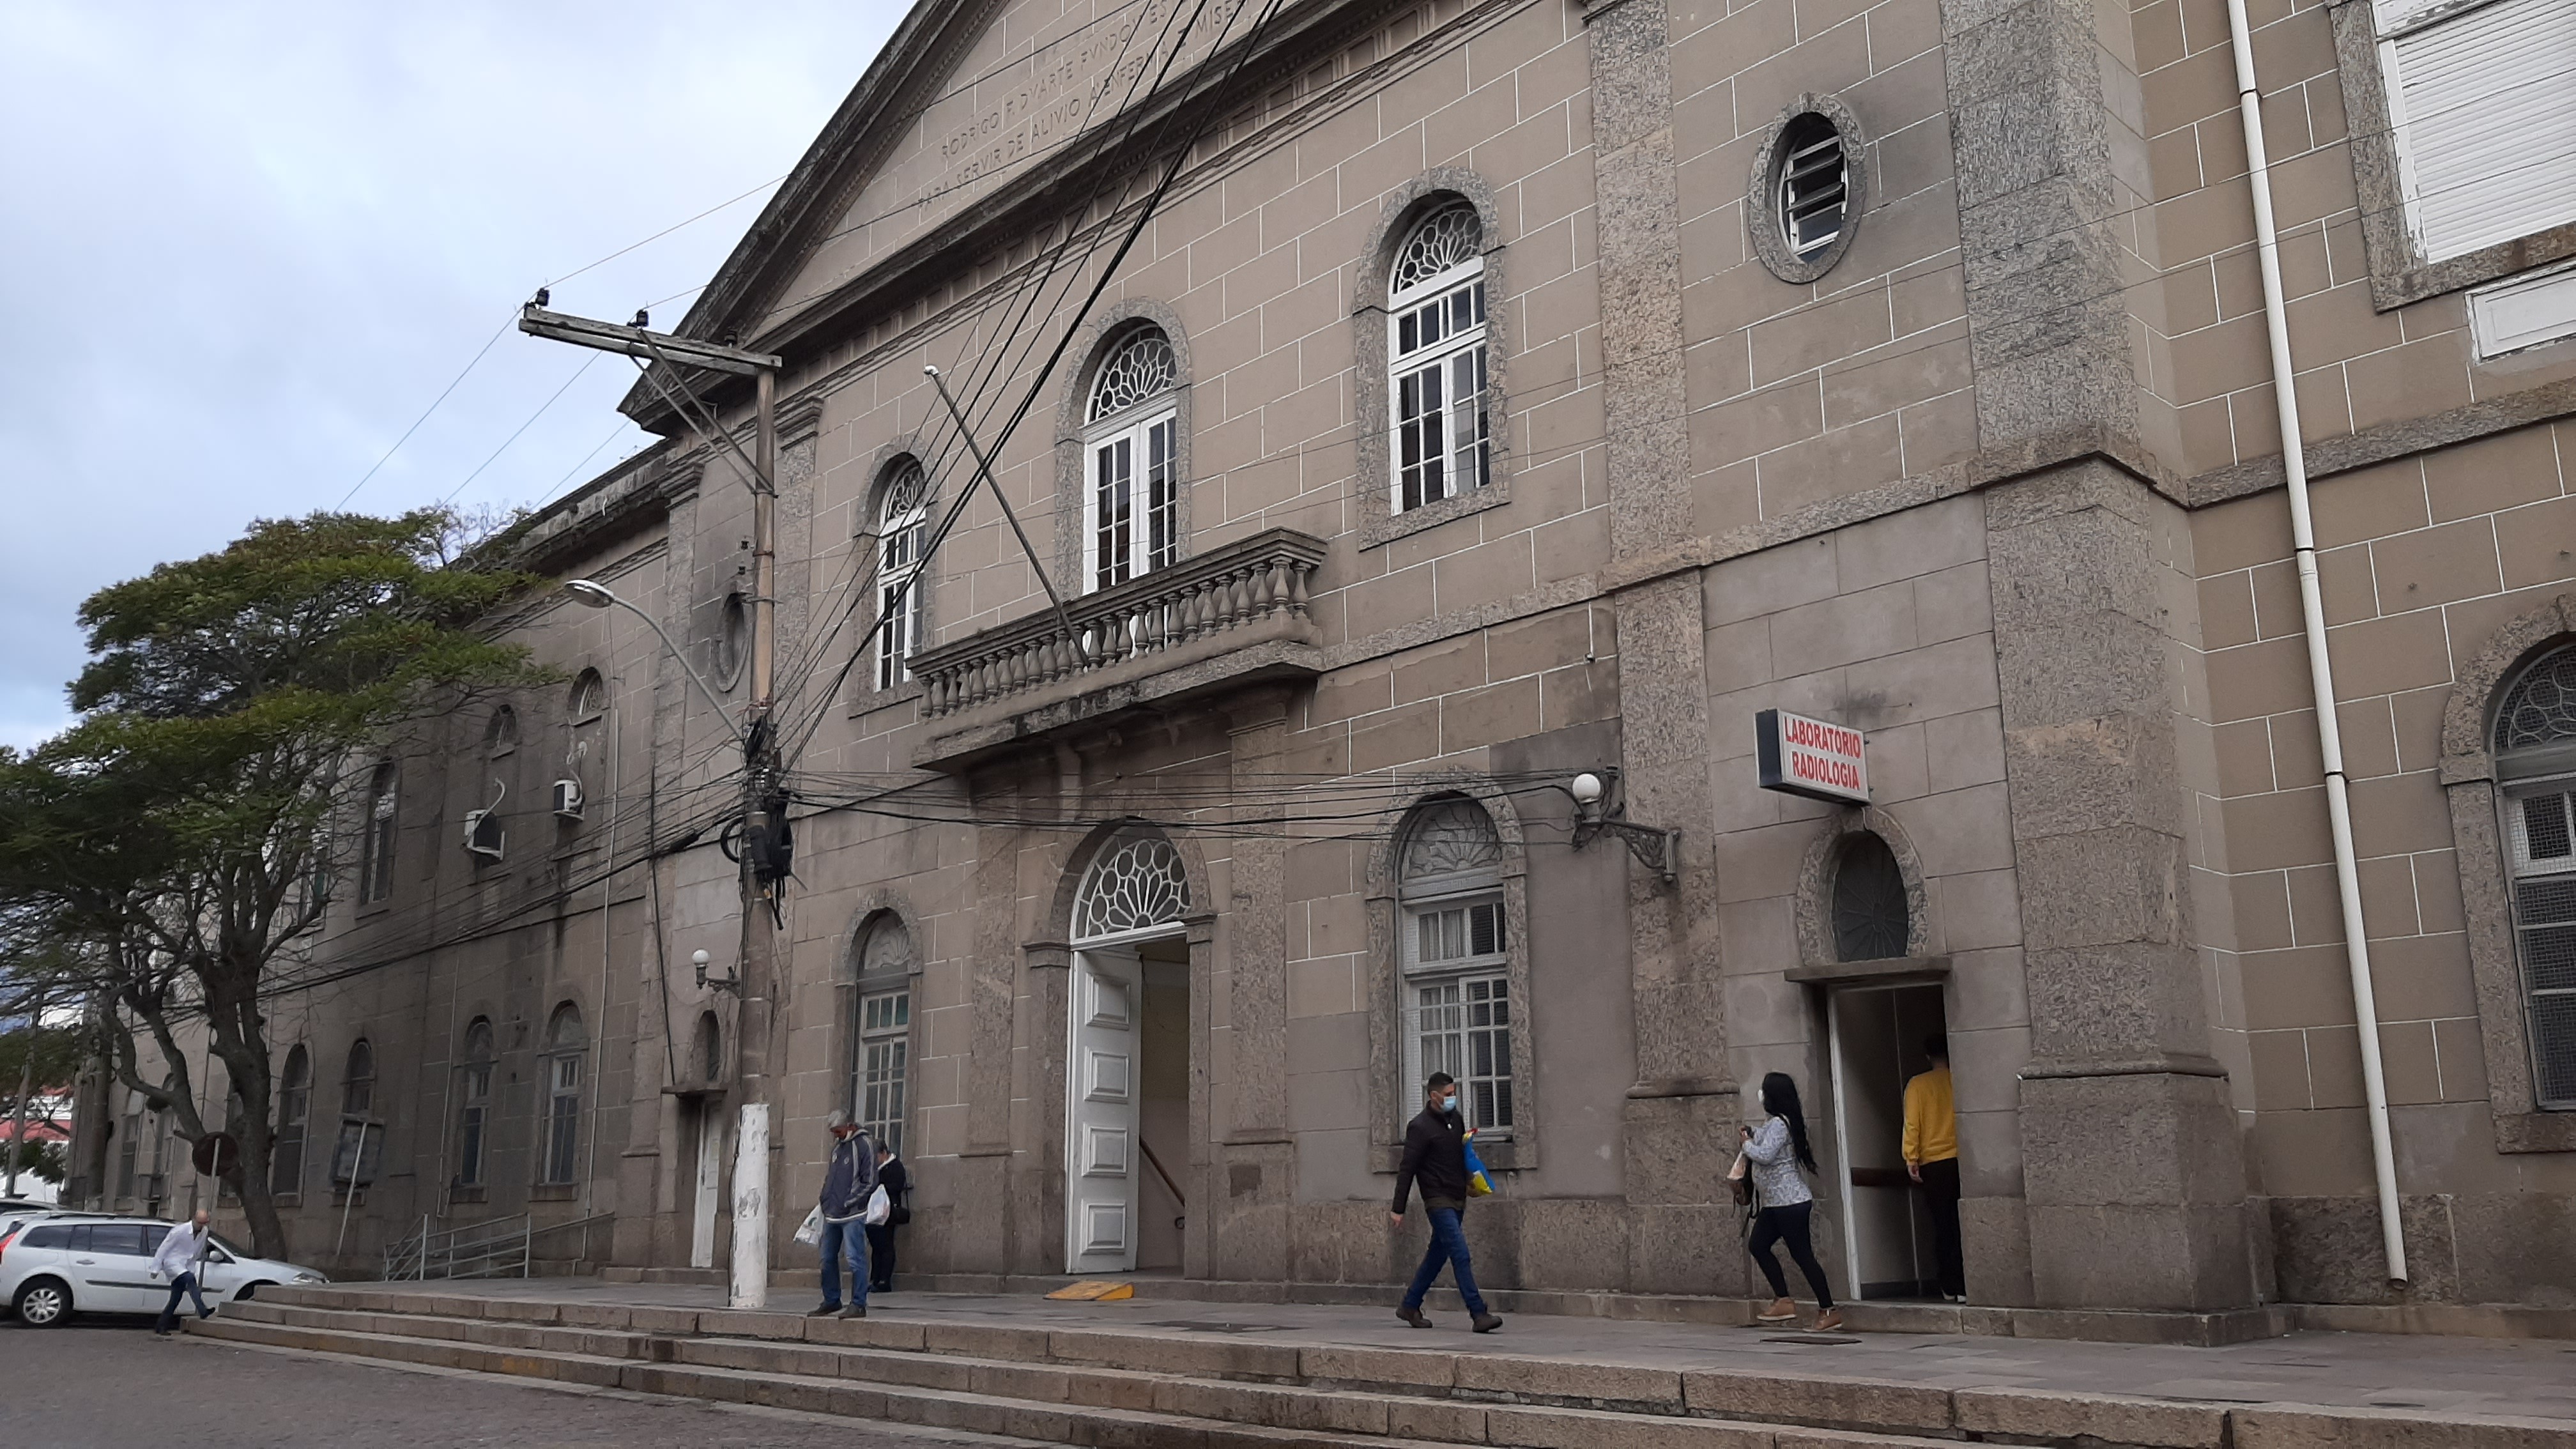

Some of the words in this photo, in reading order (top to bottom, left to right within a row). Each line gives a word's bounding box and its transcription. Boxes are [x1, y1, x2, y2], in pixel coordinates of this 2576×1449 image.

[942, 112, 999, 159] RODRIGO
[956, 148, 1002, 190] SERVIR
[1008, 132, 1024, 159] DE
[1031, 98, 1080, 143] ALIVIO
[1791, 751, 1860, 790] RADIOLOGIA
